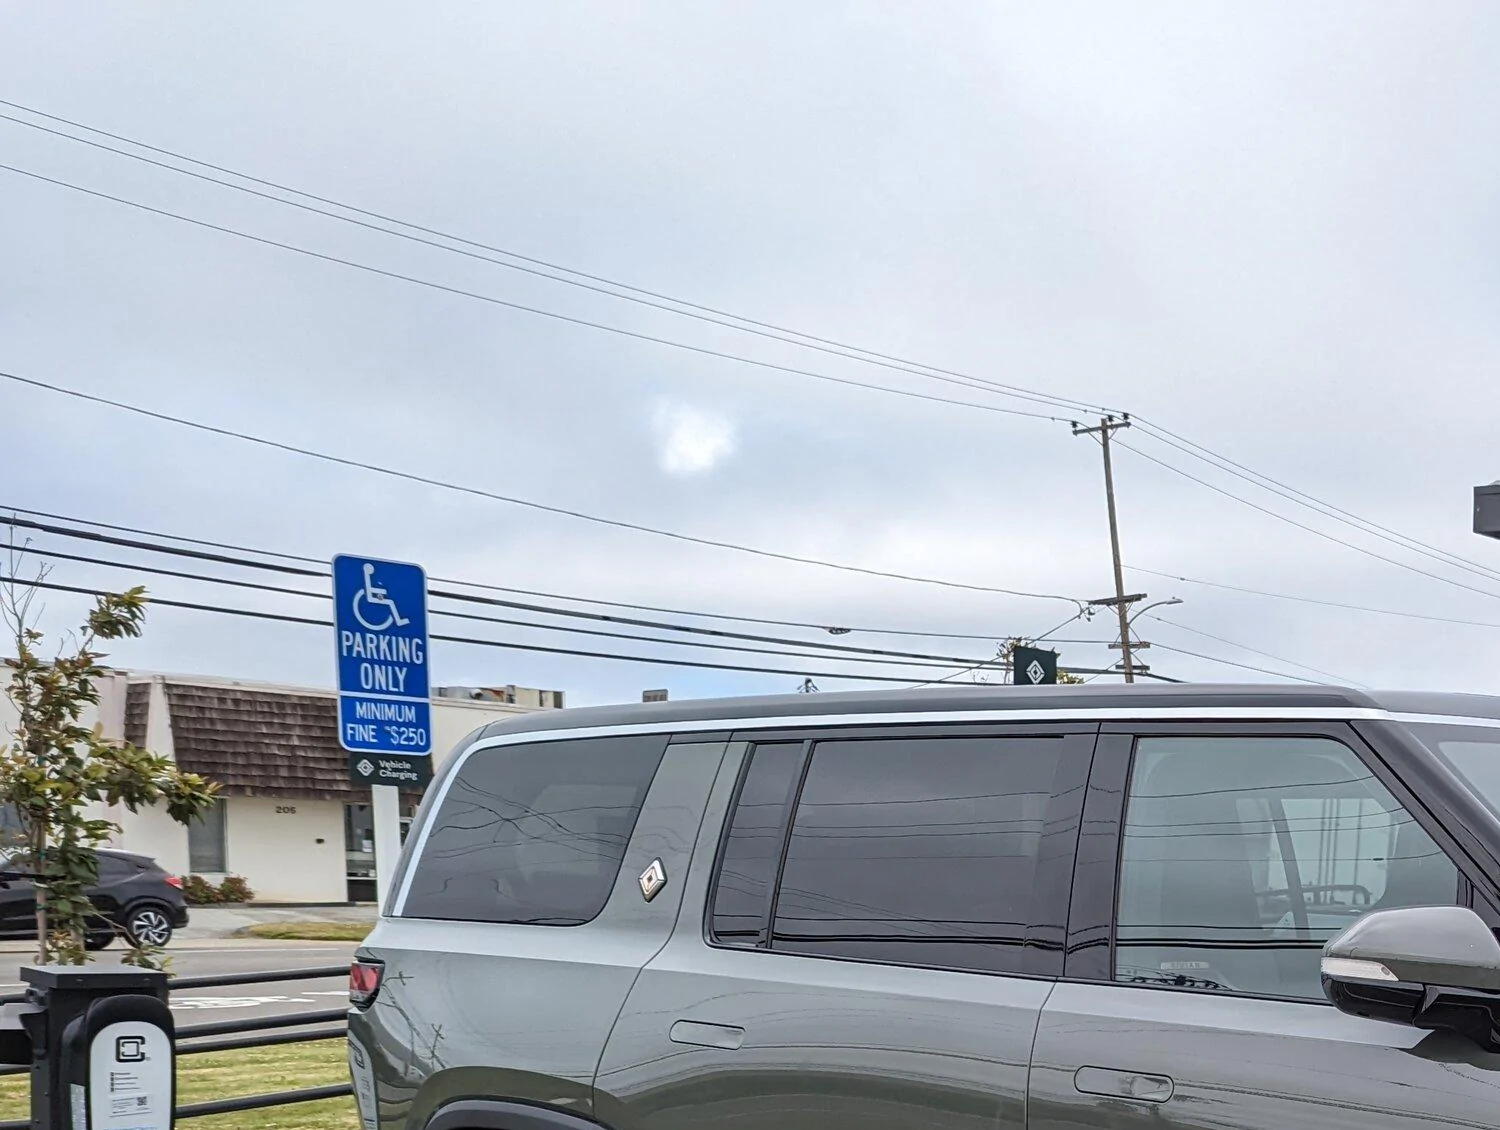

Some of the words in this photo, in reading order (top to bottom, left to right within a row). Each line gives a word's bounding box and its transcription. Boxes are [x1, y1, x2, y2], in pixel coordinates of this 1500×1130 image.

[341, 630, 424, 665] PARKING
[360, 662, 408, 693] ONLY
[355, 701, 416, 723] MINIMUM
[346, 723, 379, 743] FINE
[390, 727, 427, 746] $250
[378, 759, 412, 770] Vehicle
[379, 769, 418, 781] Charging
